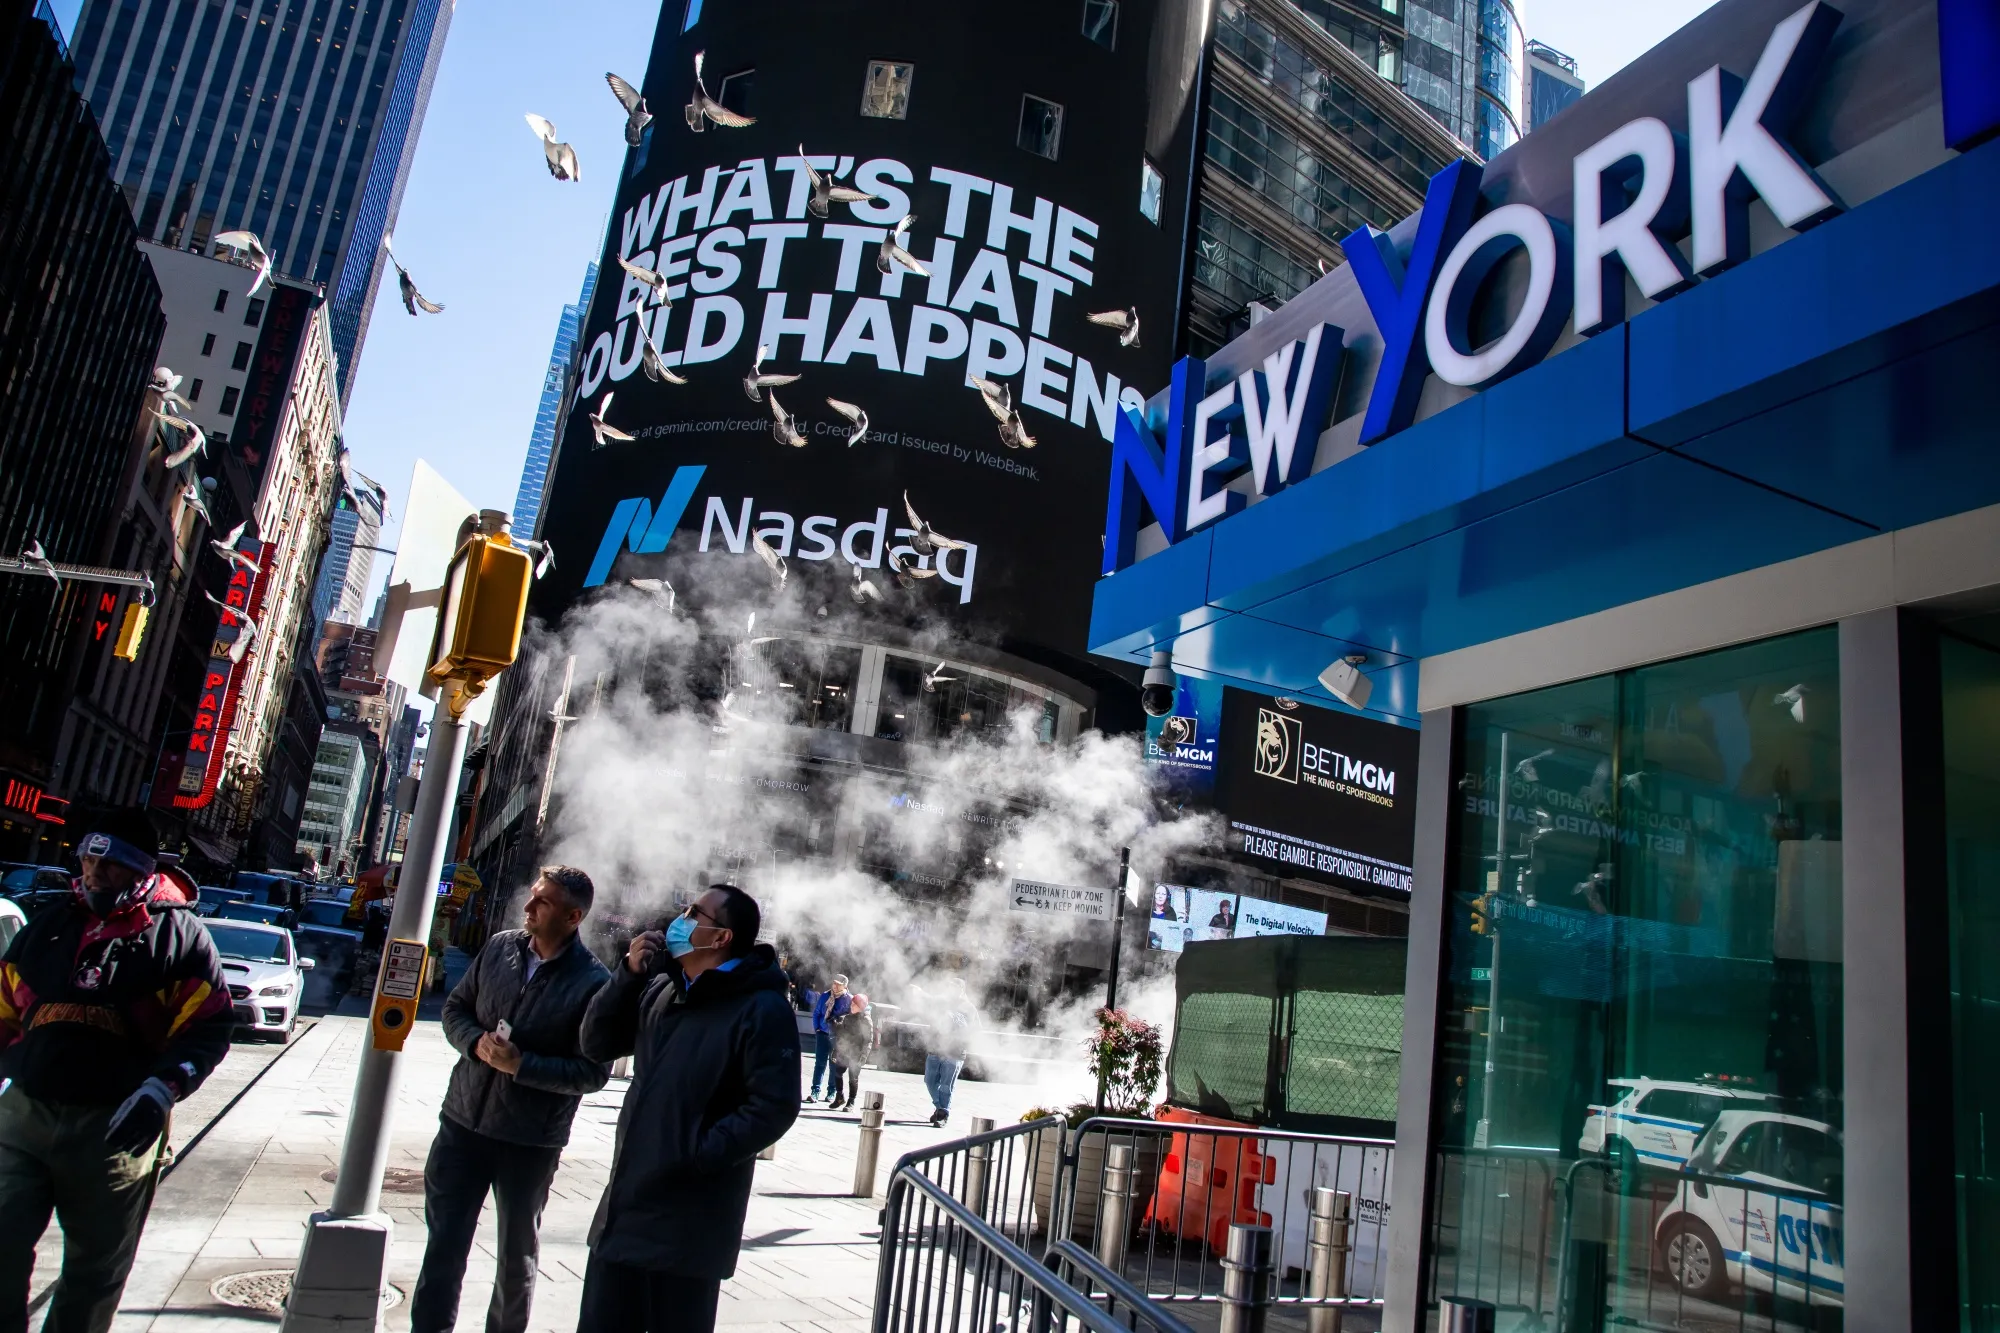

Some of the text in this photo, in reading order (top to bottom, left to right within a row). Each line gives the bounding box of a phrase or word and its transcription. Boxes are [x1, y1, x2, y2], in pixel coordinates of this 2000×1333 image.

[620, 156, 1099, 287] WHAT'S THE
[616, 223, 1074, 338] BEST THAT
[1103, 322, 1333, 576] NEW
[1341, 2, 1837, 447] YORK
[571, 295, 745, 413] OULD
[641, 426, 652, 438] at
[654, 418, 810, 439] gemini.com/credit-rd.
[815, 421, 860, 438] Credi
[863, 430, 897, 445] card
[901, 433, 950, 455] issued
[954, 445, 971, 463] by
[975, 449, 1040, 481] WebBank.
[699, 497, 977, 603] Nasdaq
[189, 672, 226, 753] PARK
[1149, 743, 1213, 762] BEMGM
[1303, 743, 1395, 795] BETMGM
[907, 799, 945, 817] Nasdaq
[1303, 772, 1393, 807] THE KING OF SPORTSBOOKS
[961, 811, 998, 828] REWRITE
[911, 873, 947, 889] Nasdaq
[1245, 834, 1278, 859] PLEASE
[1280, 843, 1315, 868] GAMBLE
[1317, 853, 1371, 882] RESPONSIBLY.
[1373, 867, 1412, 892] GAMBLING
[1016, 883, 1104, 902] PEDESTRIAN FLOW ZONE
[1053, 901, 1103, 915] KEEP MOVING
[1246, 914, 1315, 935] The Digital Velocity
